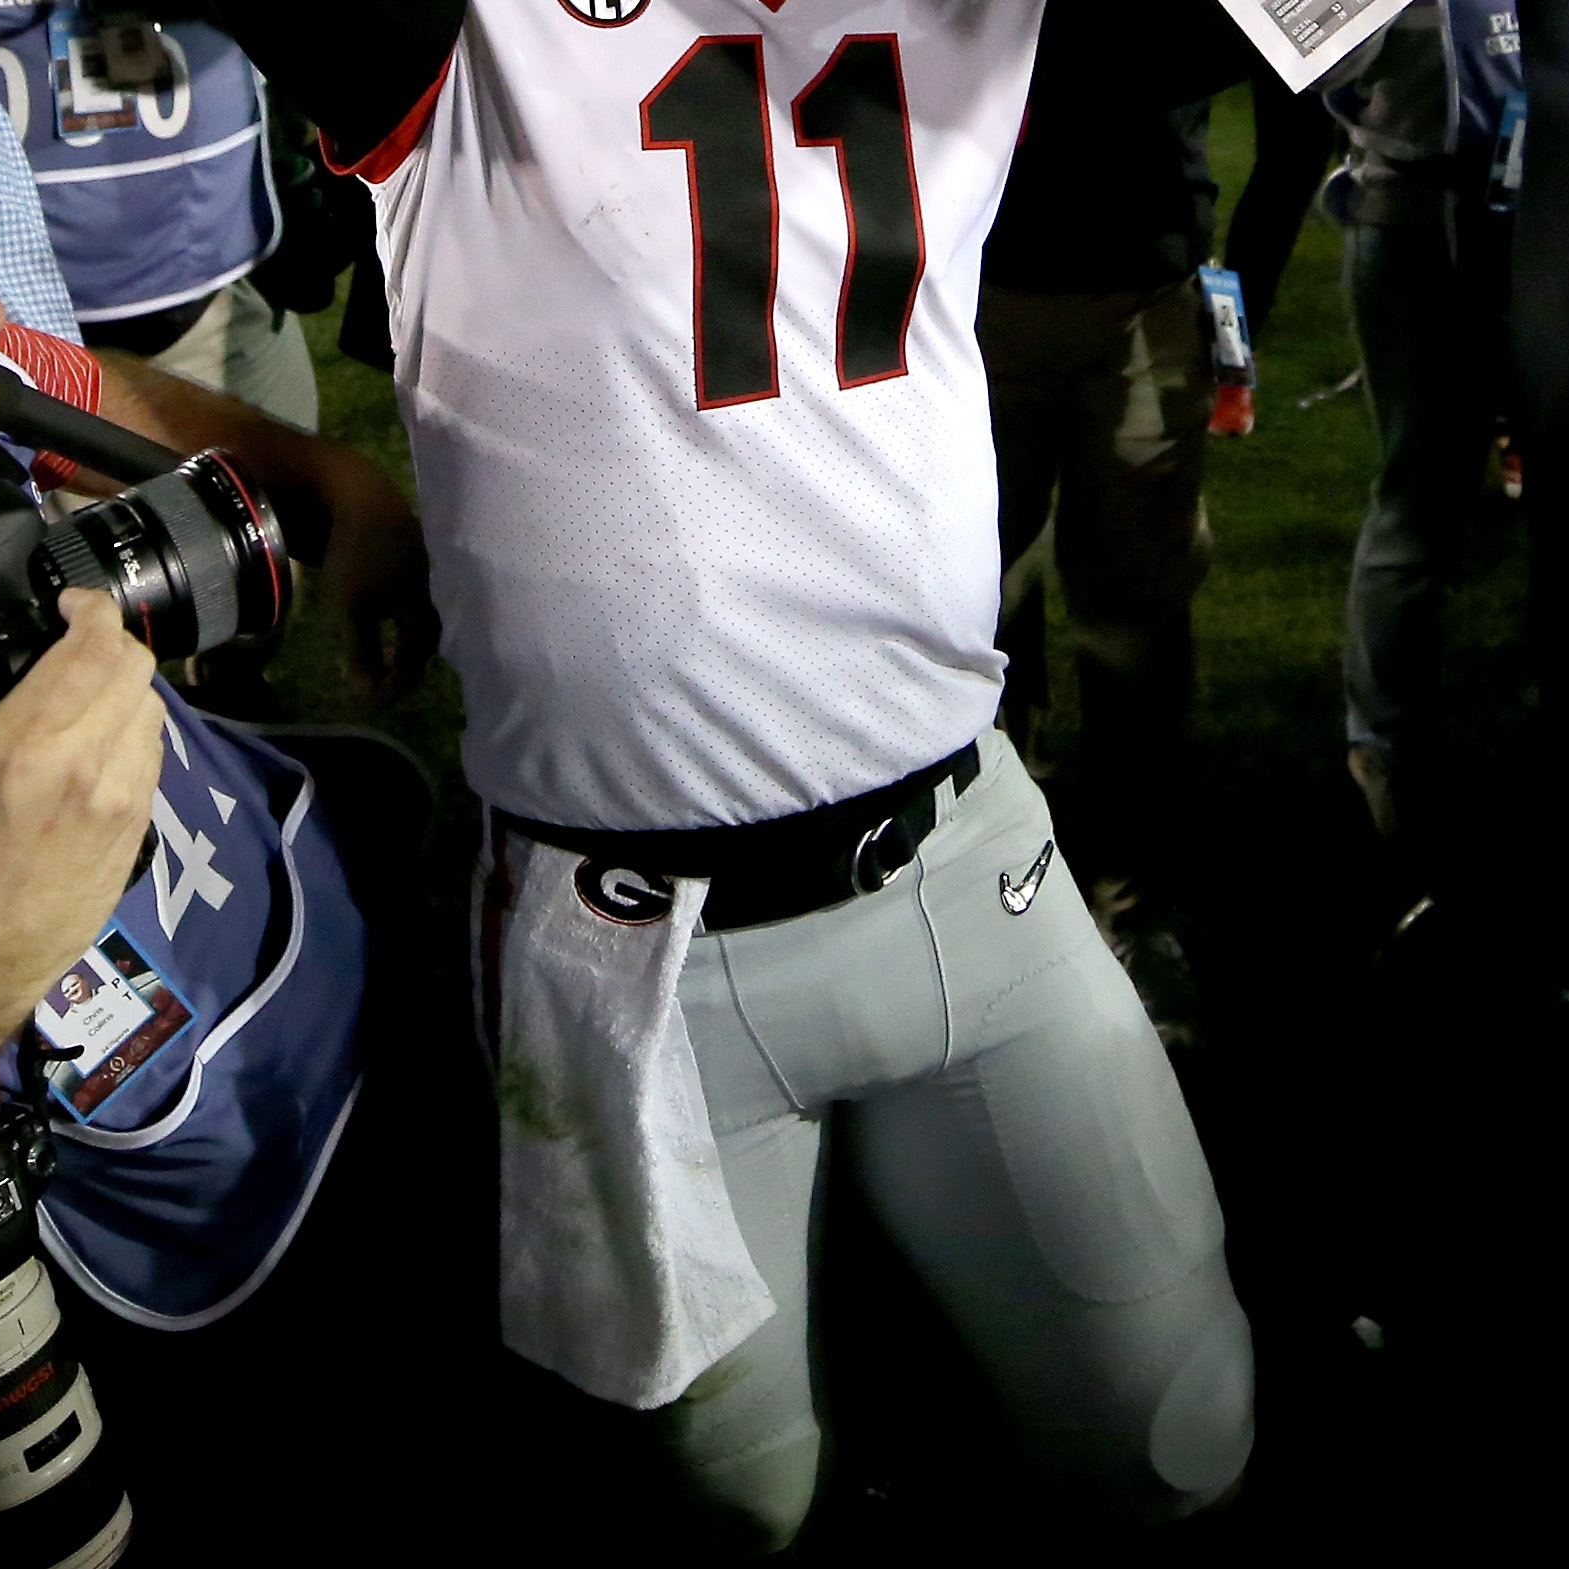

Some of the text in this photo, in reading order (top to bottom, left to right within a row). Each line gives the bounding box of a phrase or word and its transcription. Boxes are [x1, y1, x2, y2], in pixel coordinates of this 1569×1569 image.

[639, 32, 926, 411] 11
[110, 976, 123, 989] P
[122, 990, 134, 1002] T
[81, 1004, 104, 1027] Chris
[86, 1011, 114, 1038] Collins
